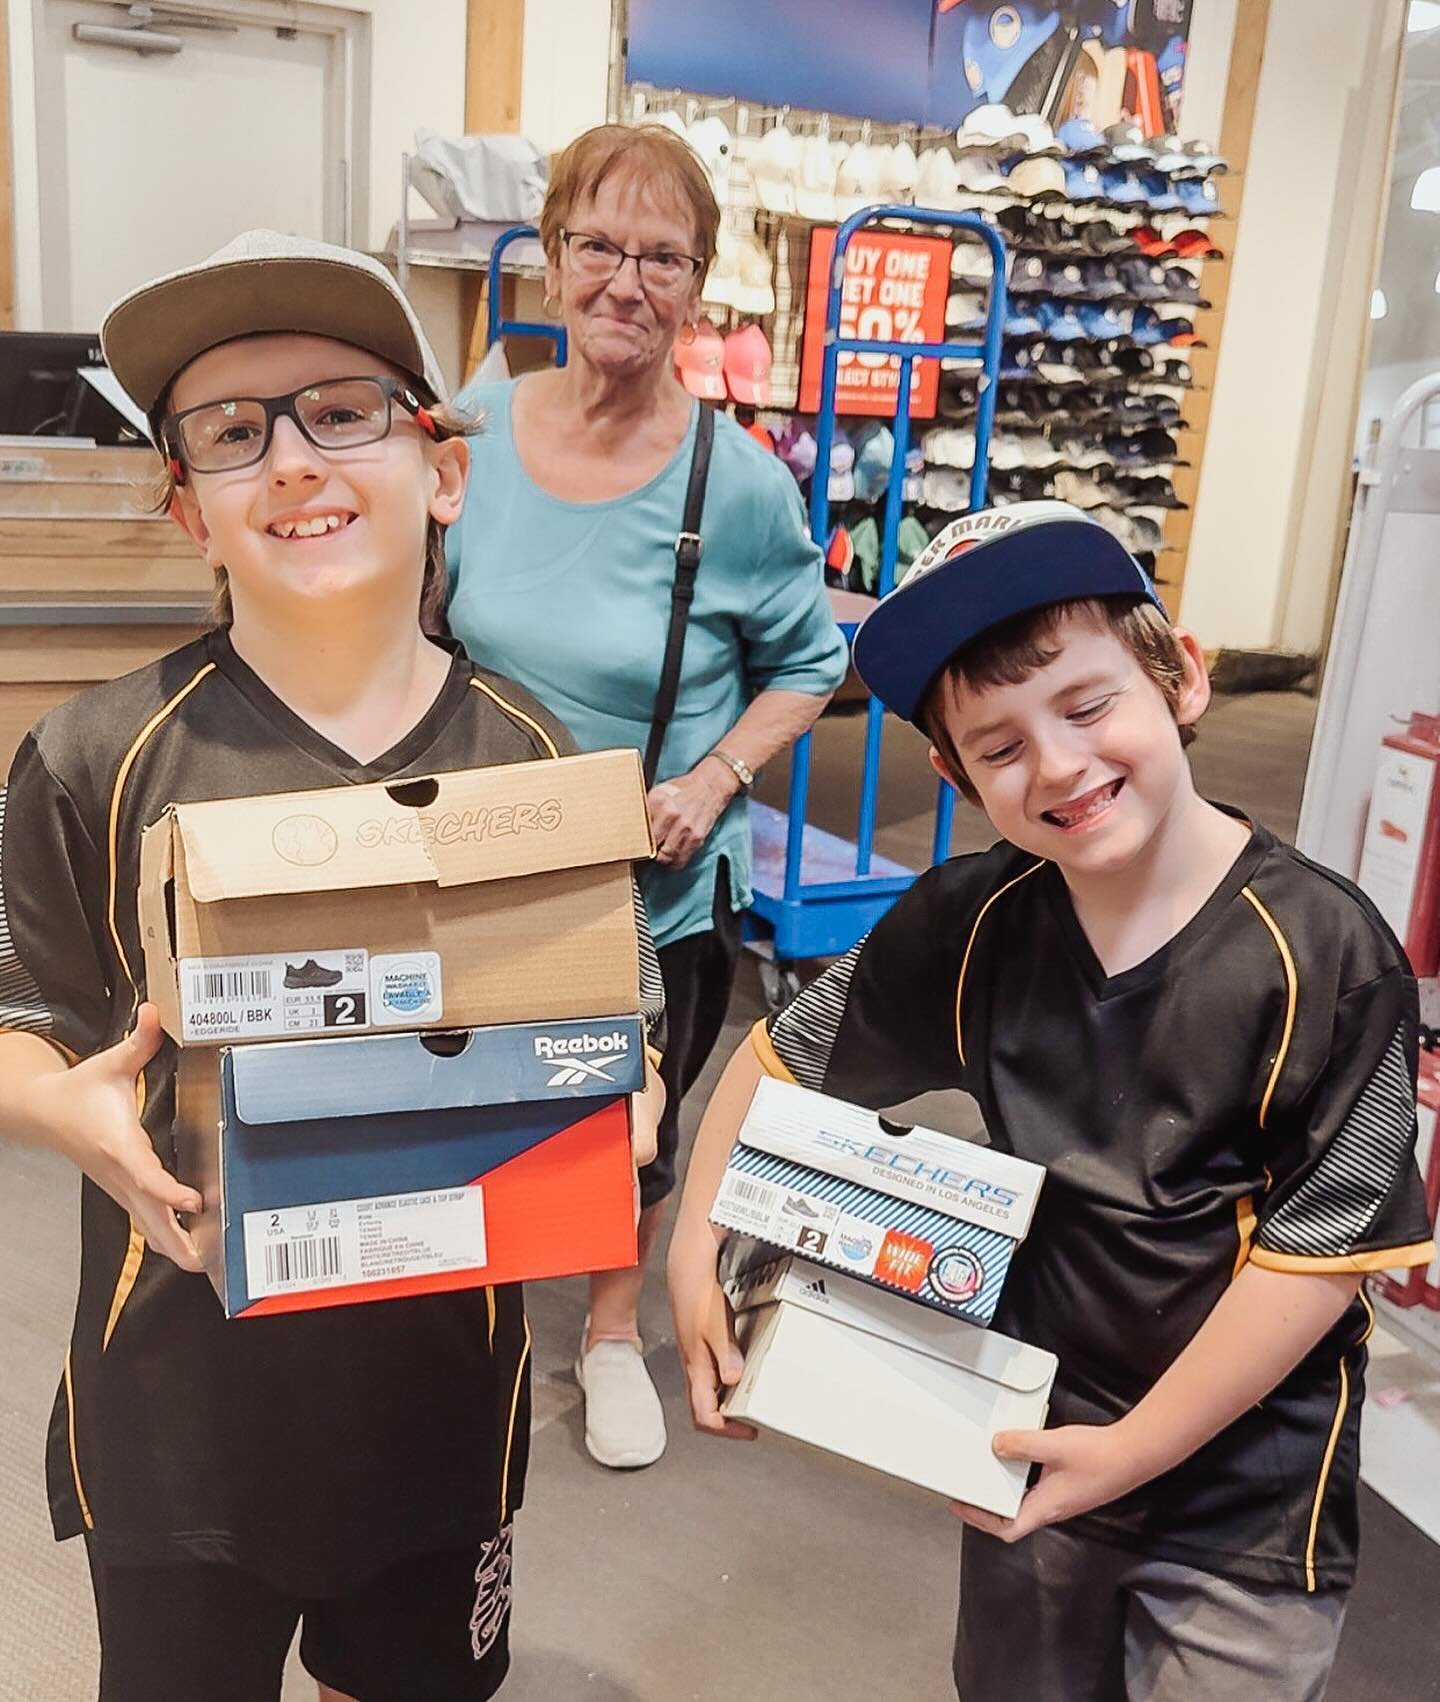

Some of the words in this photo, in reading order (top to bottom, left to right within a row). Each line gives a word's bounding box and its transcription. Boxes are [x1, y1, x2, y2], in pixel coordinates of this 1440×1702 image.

[846, 246, 881, 275] UY
[884, 249, 932, 279] ONE
[842, 274, 877, 305] ET
[878, 278, 926, 309] ONE
[355, 798, 563, 849] SKECHERS
[189, 1010, 237, 1026] 404800L
[247, 1008, 273, 1023] BBK
[335, 996, 356, 1025] 2
[534, 1030, 629, 1058] Reebok
[812, 1130, 1026, 1207] SKECHERS
[872, 1166, 924, 1193] DESIGNED
[924, 1183, 935, 1195] IN
[938, 1187, 959, 1202] LOS
[961, 1196, 1010, 1221] ANGELES
[267, 1227, 286, 1237] USA
[271, 1213, 280, 1227] 2
[803, 1231, 821, 1252] 2
[889, 1258, 914, 1276] FIT
